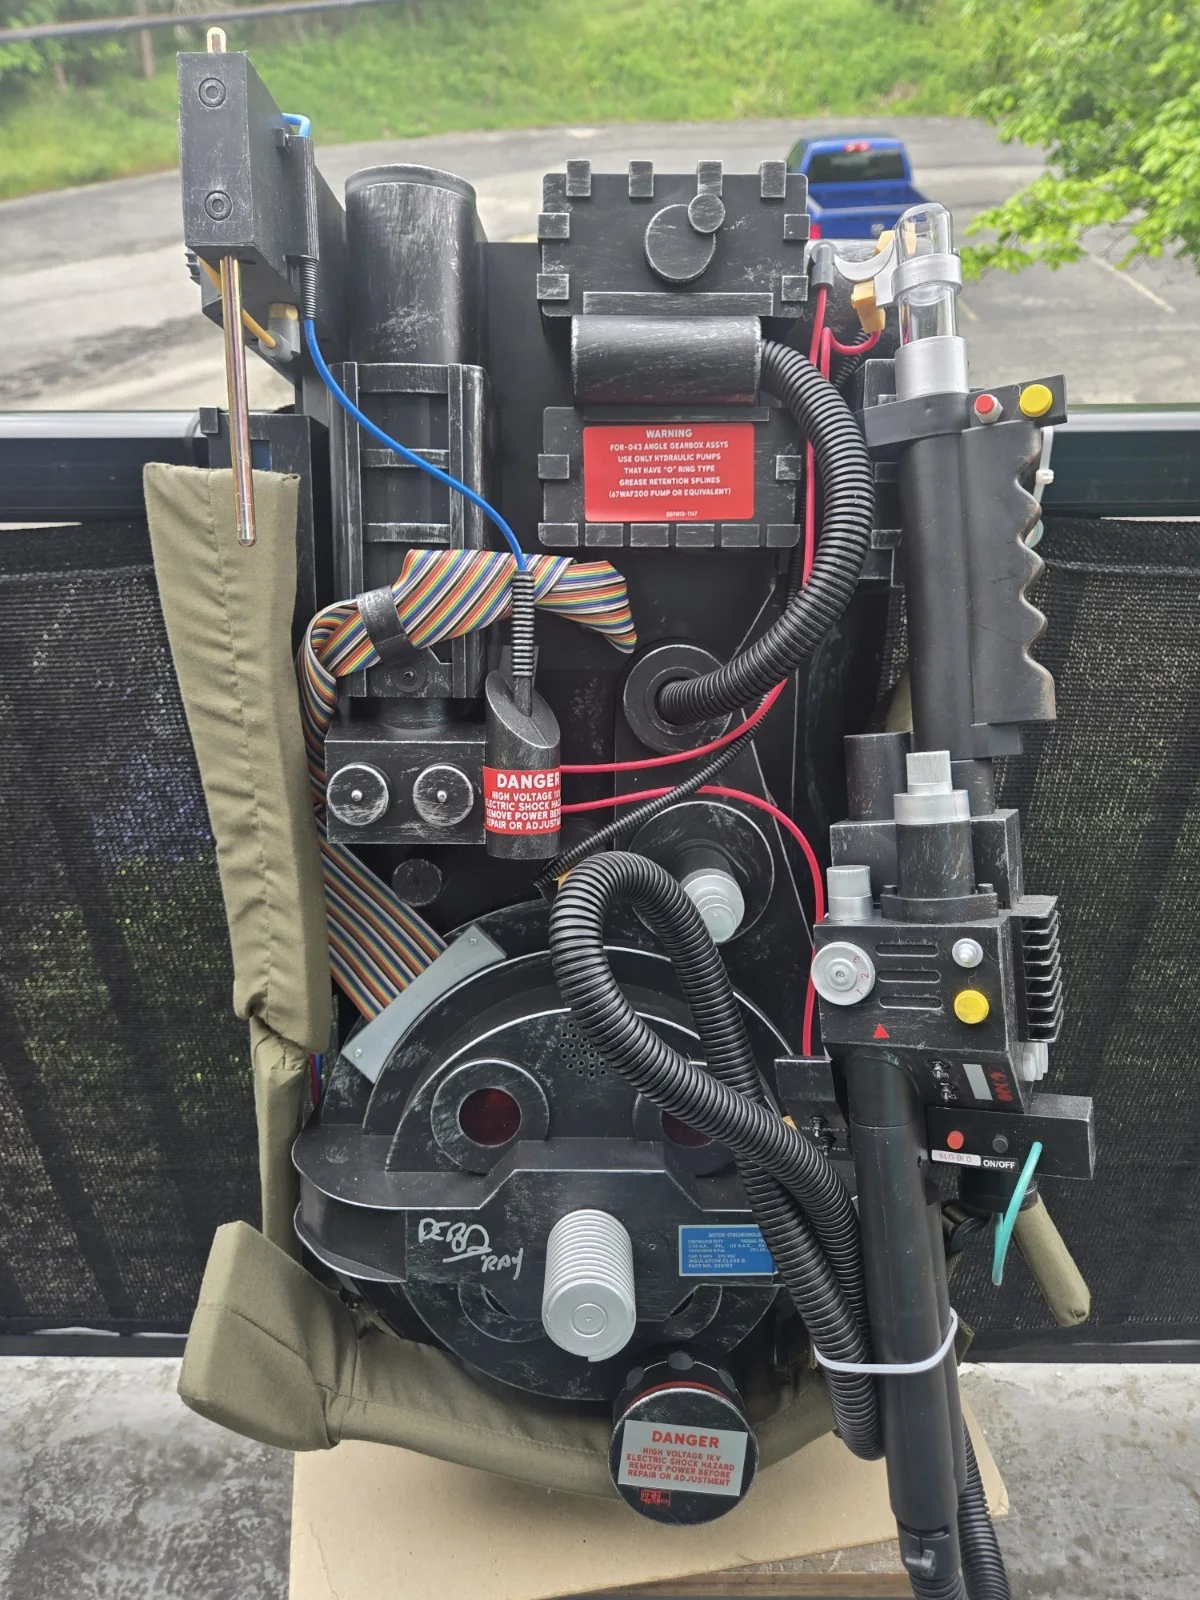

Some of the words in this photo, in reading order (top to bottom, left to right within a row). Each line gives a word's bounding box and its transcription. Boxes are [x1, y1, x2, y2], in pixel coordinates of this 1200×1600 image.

[646, 428, 692, 438] WARNING
[610, 444, 642, 452] FOR-043
[670, 442, 704, 450] GEARBOX
[705, 440, 728, 448] ASSYS
[618, 455, 632, 463] USE
[654, 454, 694, 462] HYDRAULIC
[619, 478, 648, 486] GREASE
[649, 477, 689, 485] RETENTION
[690, 476, 720, 484] SPLINES
[609, 490, 649, 498] (67WAF200
[684, 488, 732, 496] EQUIVALENT)
[497, 772, 560, 789] DANGER
[492, 790, 510, 801] HIGH
[513, 791, 552, 802] VOLTAGE
[518, 801, 550, 811] SHOCK
[486, 808, 512, 820] REMOVE
[515, 810, 548, 820] POWER
[486, 817, 506, 830] REPAIR
[509, 821, 523, 830] OR
[983, 1160, 1016, 1169] ON/OFF
[652, 1430, 720, 1448] DANGER
[642, 1447, 663, 1456] HIGH
[666, 1449, 703, 1460] VOLTAGE
[626, 1453, 667, 1464] ELECTRIC
[670, 1459, 698, 1468] SHOCK
[701, 1462, 735, 1471] HAZARD
[628, 1461, 663, 1472] REMOVE
[665, 1465, 696, 1475] POWER
[699, 1468, 731, 1478] BEFORE
[627, 1468, 657, 1478] REPAIR
[660, 1472, 671, 1480] OR
[674, 1474, 731, 1486] ADJUSTMENT
